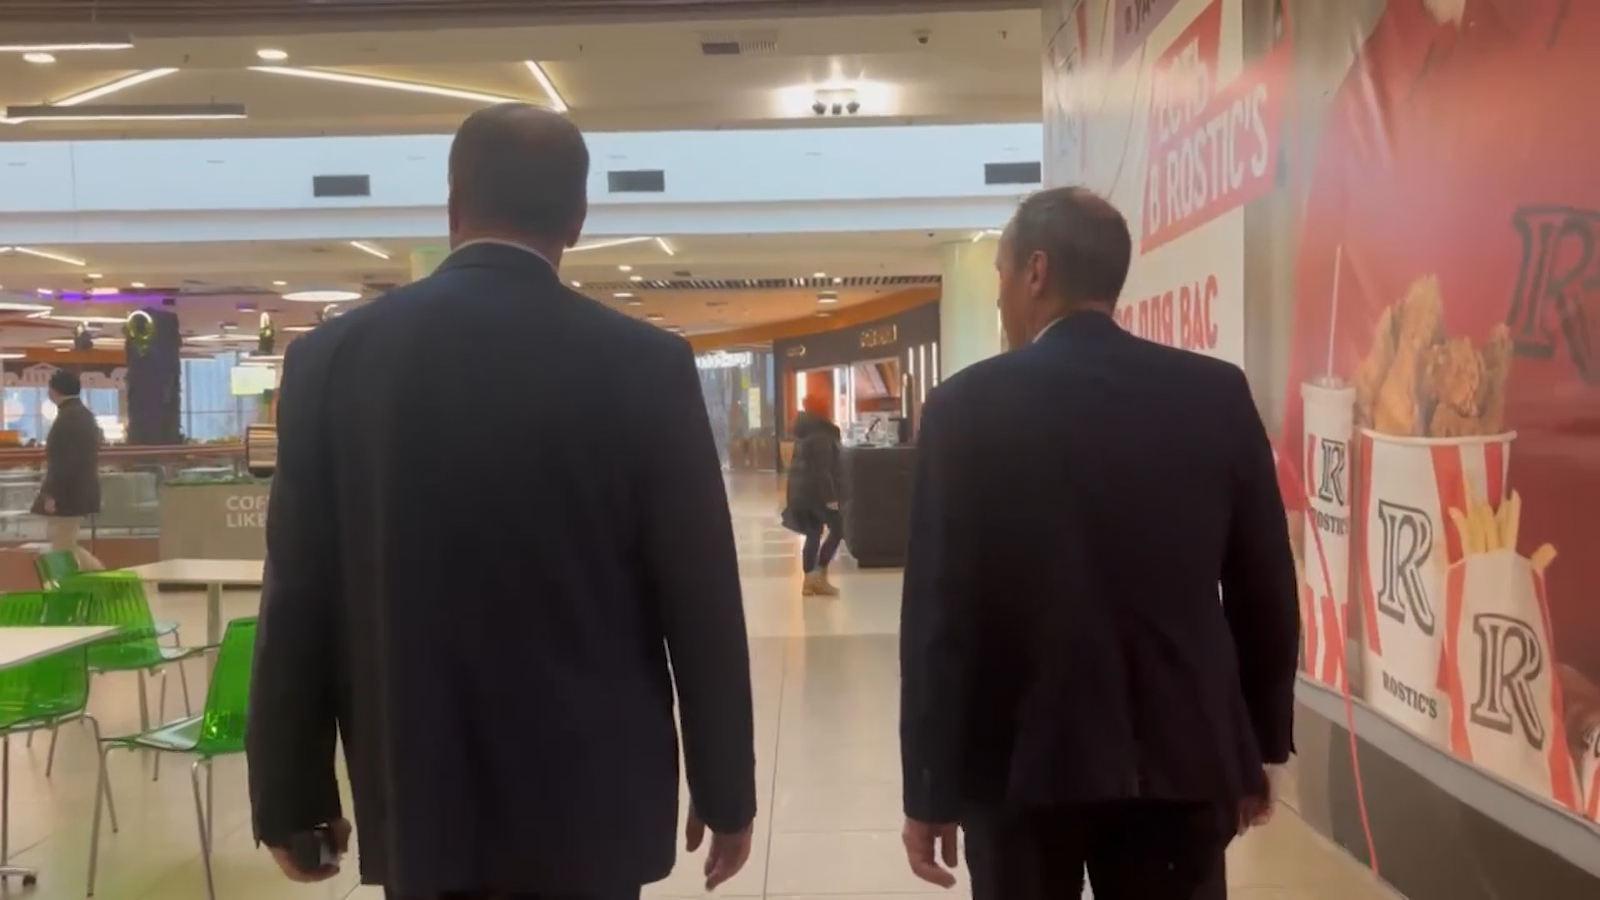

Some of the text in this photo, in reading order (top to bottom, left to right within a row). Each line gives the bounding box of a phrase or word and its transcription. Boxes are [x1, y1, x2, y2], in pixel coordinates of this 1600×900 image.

[1167, 83, 1268, 228] ROSTIC'S
[1180, 275, 1218, 349] ВАС
[226, 495, 270, 510] COF
[1319, 438, 1345, 507] R
[1377, 498, 1435, 637] R
[1382, 670, 1437, 719] ROSTIC'S
[1469, 612, 1545, 751] R
